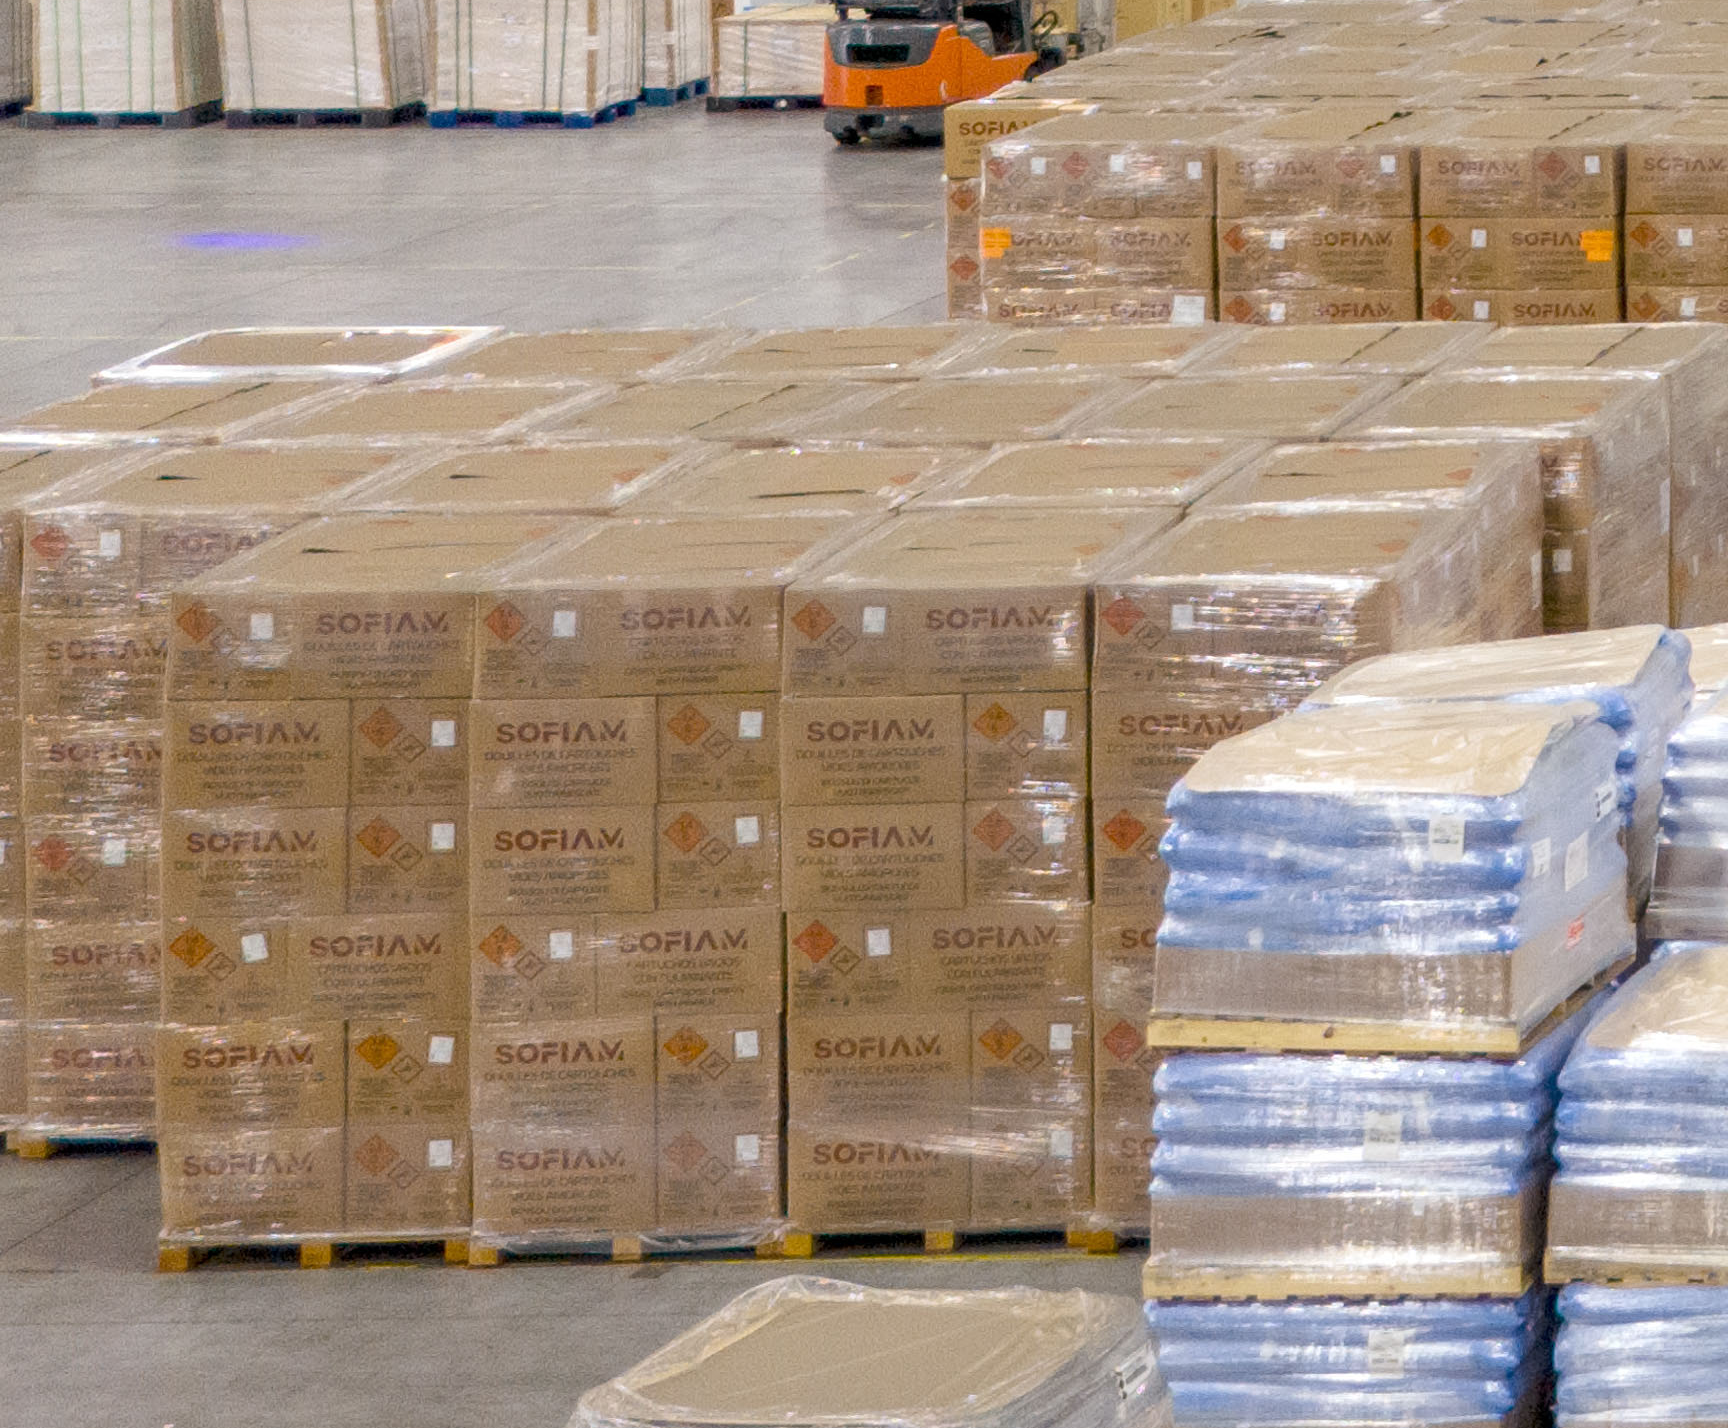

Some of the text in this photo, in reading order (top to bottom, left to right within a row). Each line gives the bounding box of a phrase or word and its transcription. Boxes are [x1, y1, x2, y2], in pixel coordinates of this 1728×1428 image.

[1438, 159, 1521, 175] SOFIAM
[1643, 157, 1728, 173] SOFIAM
[1312, 231, 1393, 248] SOFIAM
[1511, 231, 1581, 247] SOFIA
[1515, 302, 1596, 319] SOFIAM
[316, 611, 450, 635] SOFIAM
[619, 605, 752, 631] SOFIAM
[925, 606, 1054, 630] SOFIAM
[188, 721, 320, 746] SOFIAM
[496, 719, 627, 744] SOFIAM
[807, 718, 935, 743] SOFIAM
[186, 829, 319, 854] SOFIAM
[494, 827, 625, 852] SOFIAM
[807, 825, 934, 849] SOFIAM
[309, 933, 443, 958] SOFIAM
[619, 928, 748, 953] SOFIAM
[932, 925, 1058, 950] SOFIAM
[182, 1043, 315, 1070] SOFIAM
[496, 1039, 625, 1065] SOFIAM
[814, 1034, 941, 1059] SOFIAM
[182, 1151, 314, 1177] SOFIAM
[496, 1147, 626, 1171] SOFIAM
